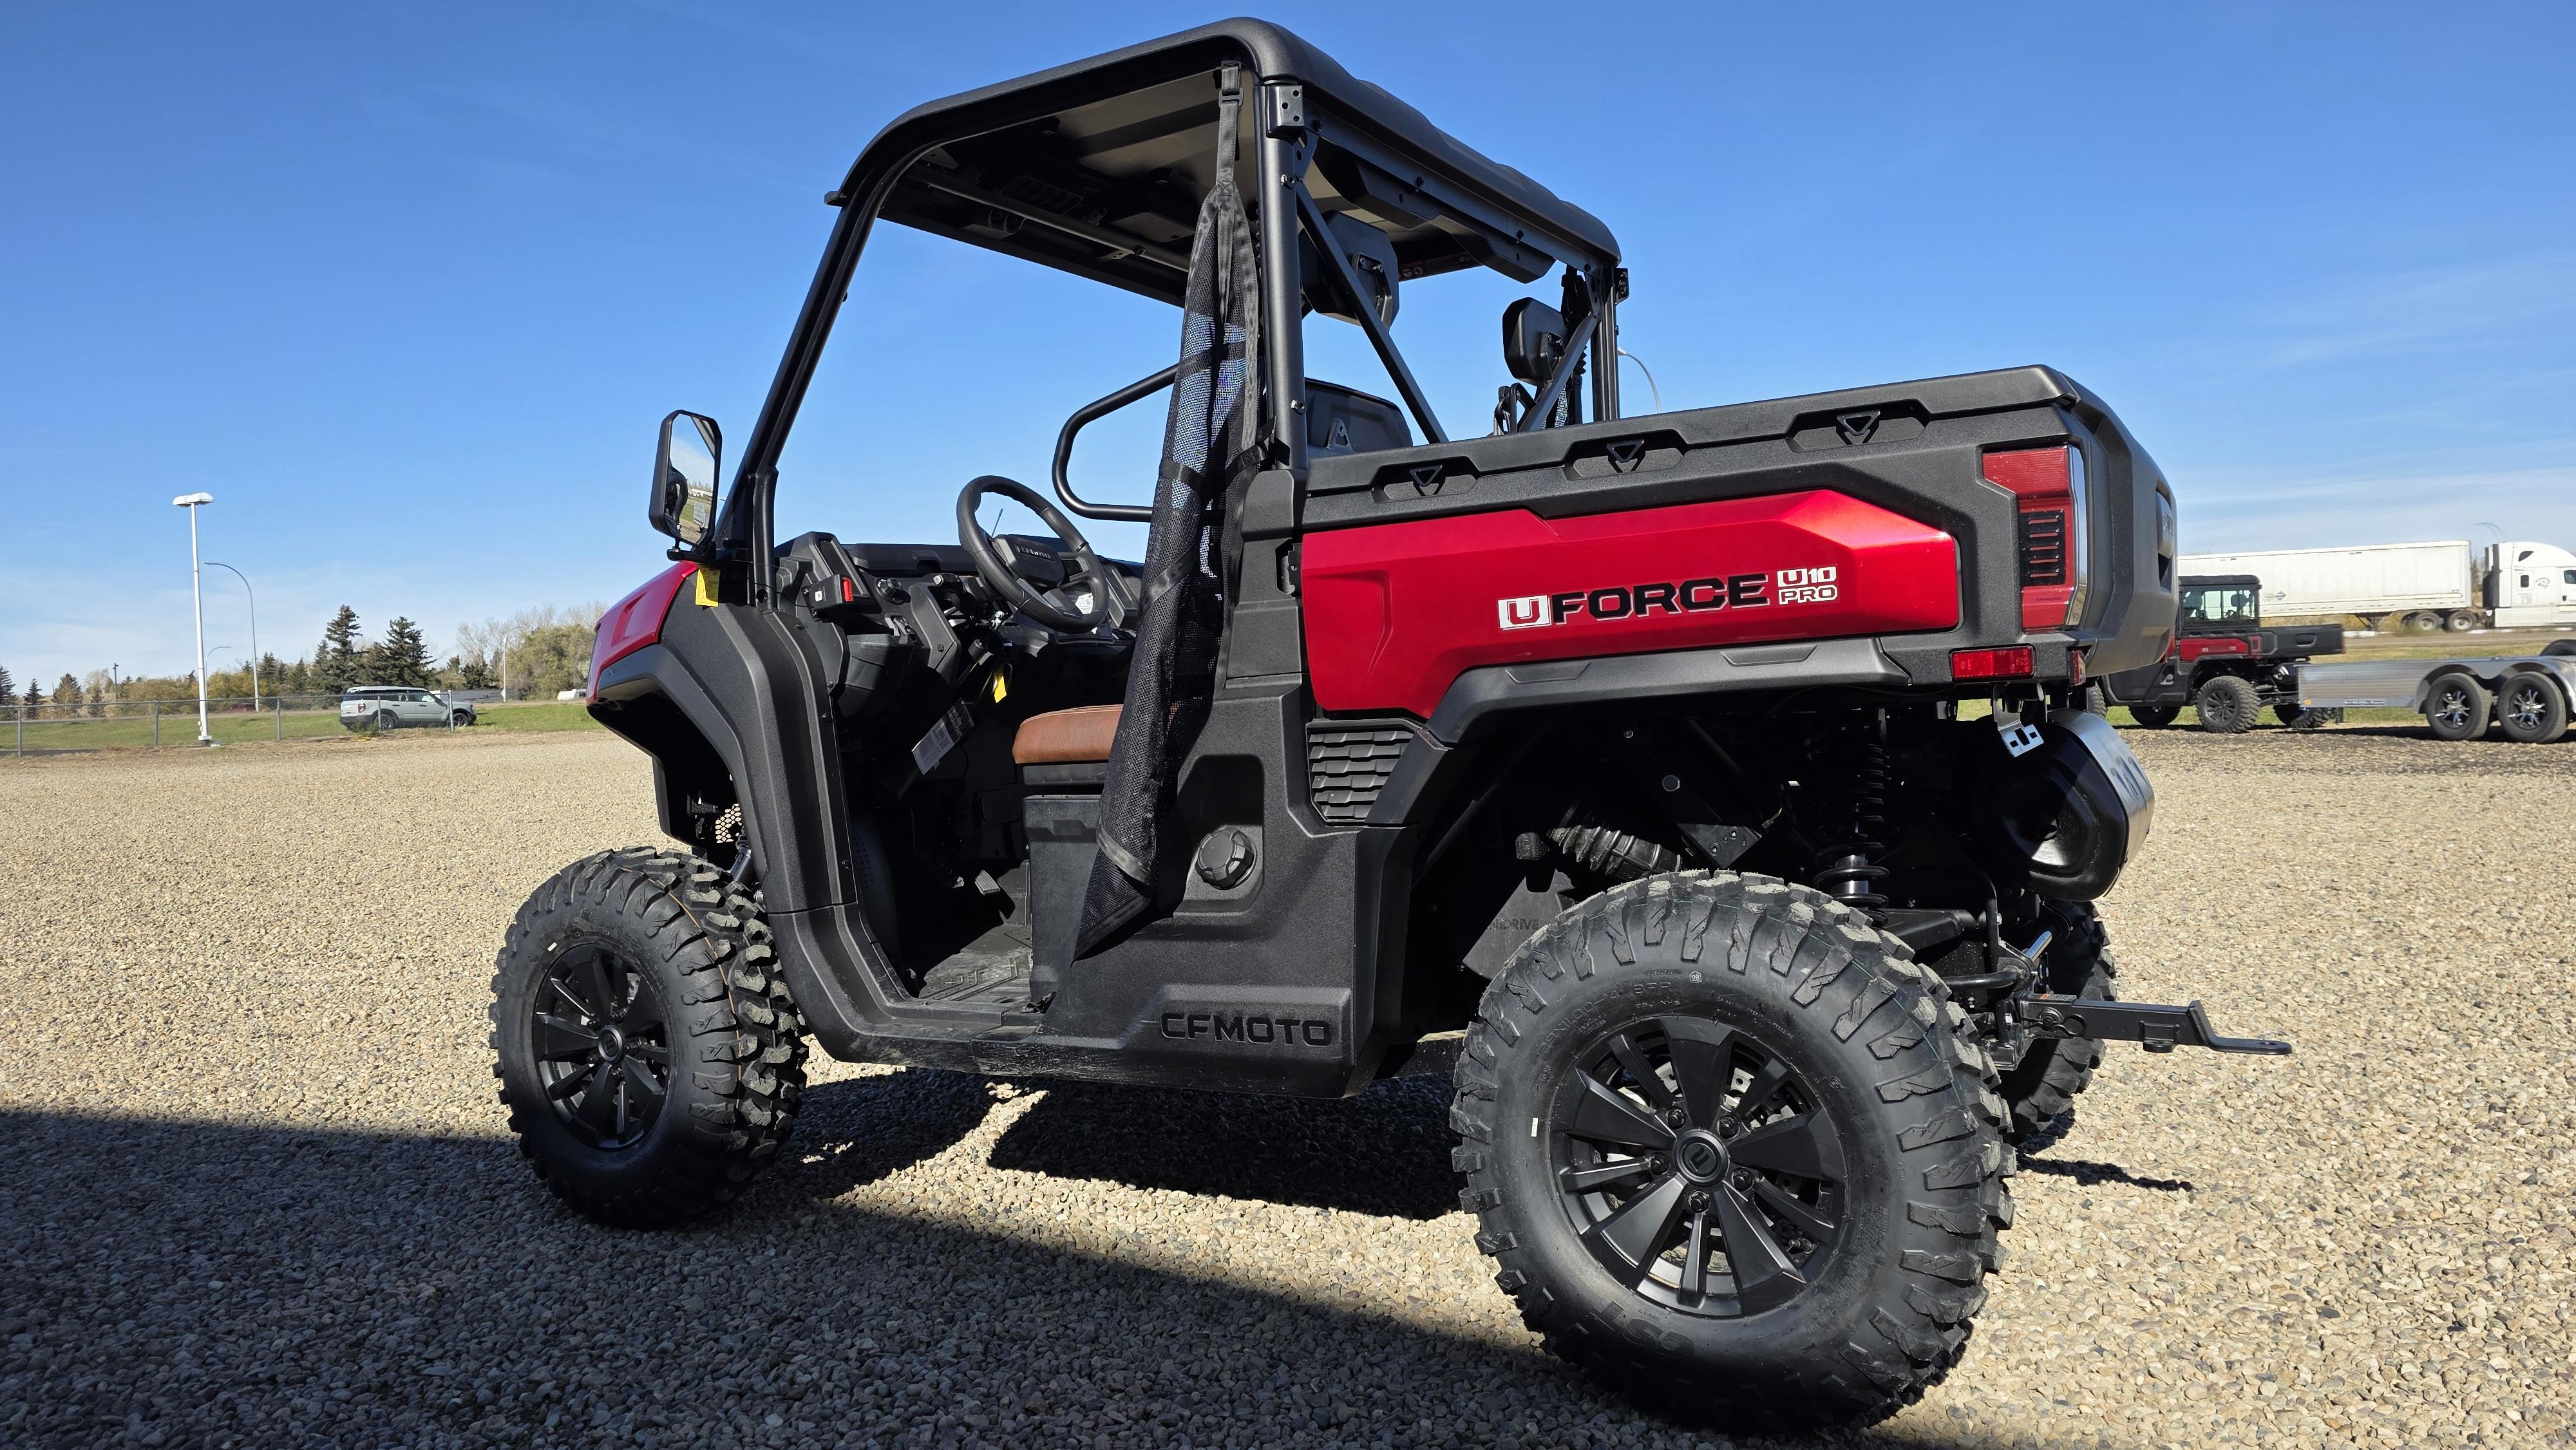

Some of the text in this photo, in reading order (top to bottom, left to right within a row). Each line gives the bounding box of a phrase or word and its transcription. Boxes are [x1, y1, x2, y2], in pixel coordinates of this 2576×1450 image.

[1777, 566, 1837, 587] U10
[1779, 585, 1838, 605] PRO
[1160, 1012, 1332, 1048] CFMOTO
